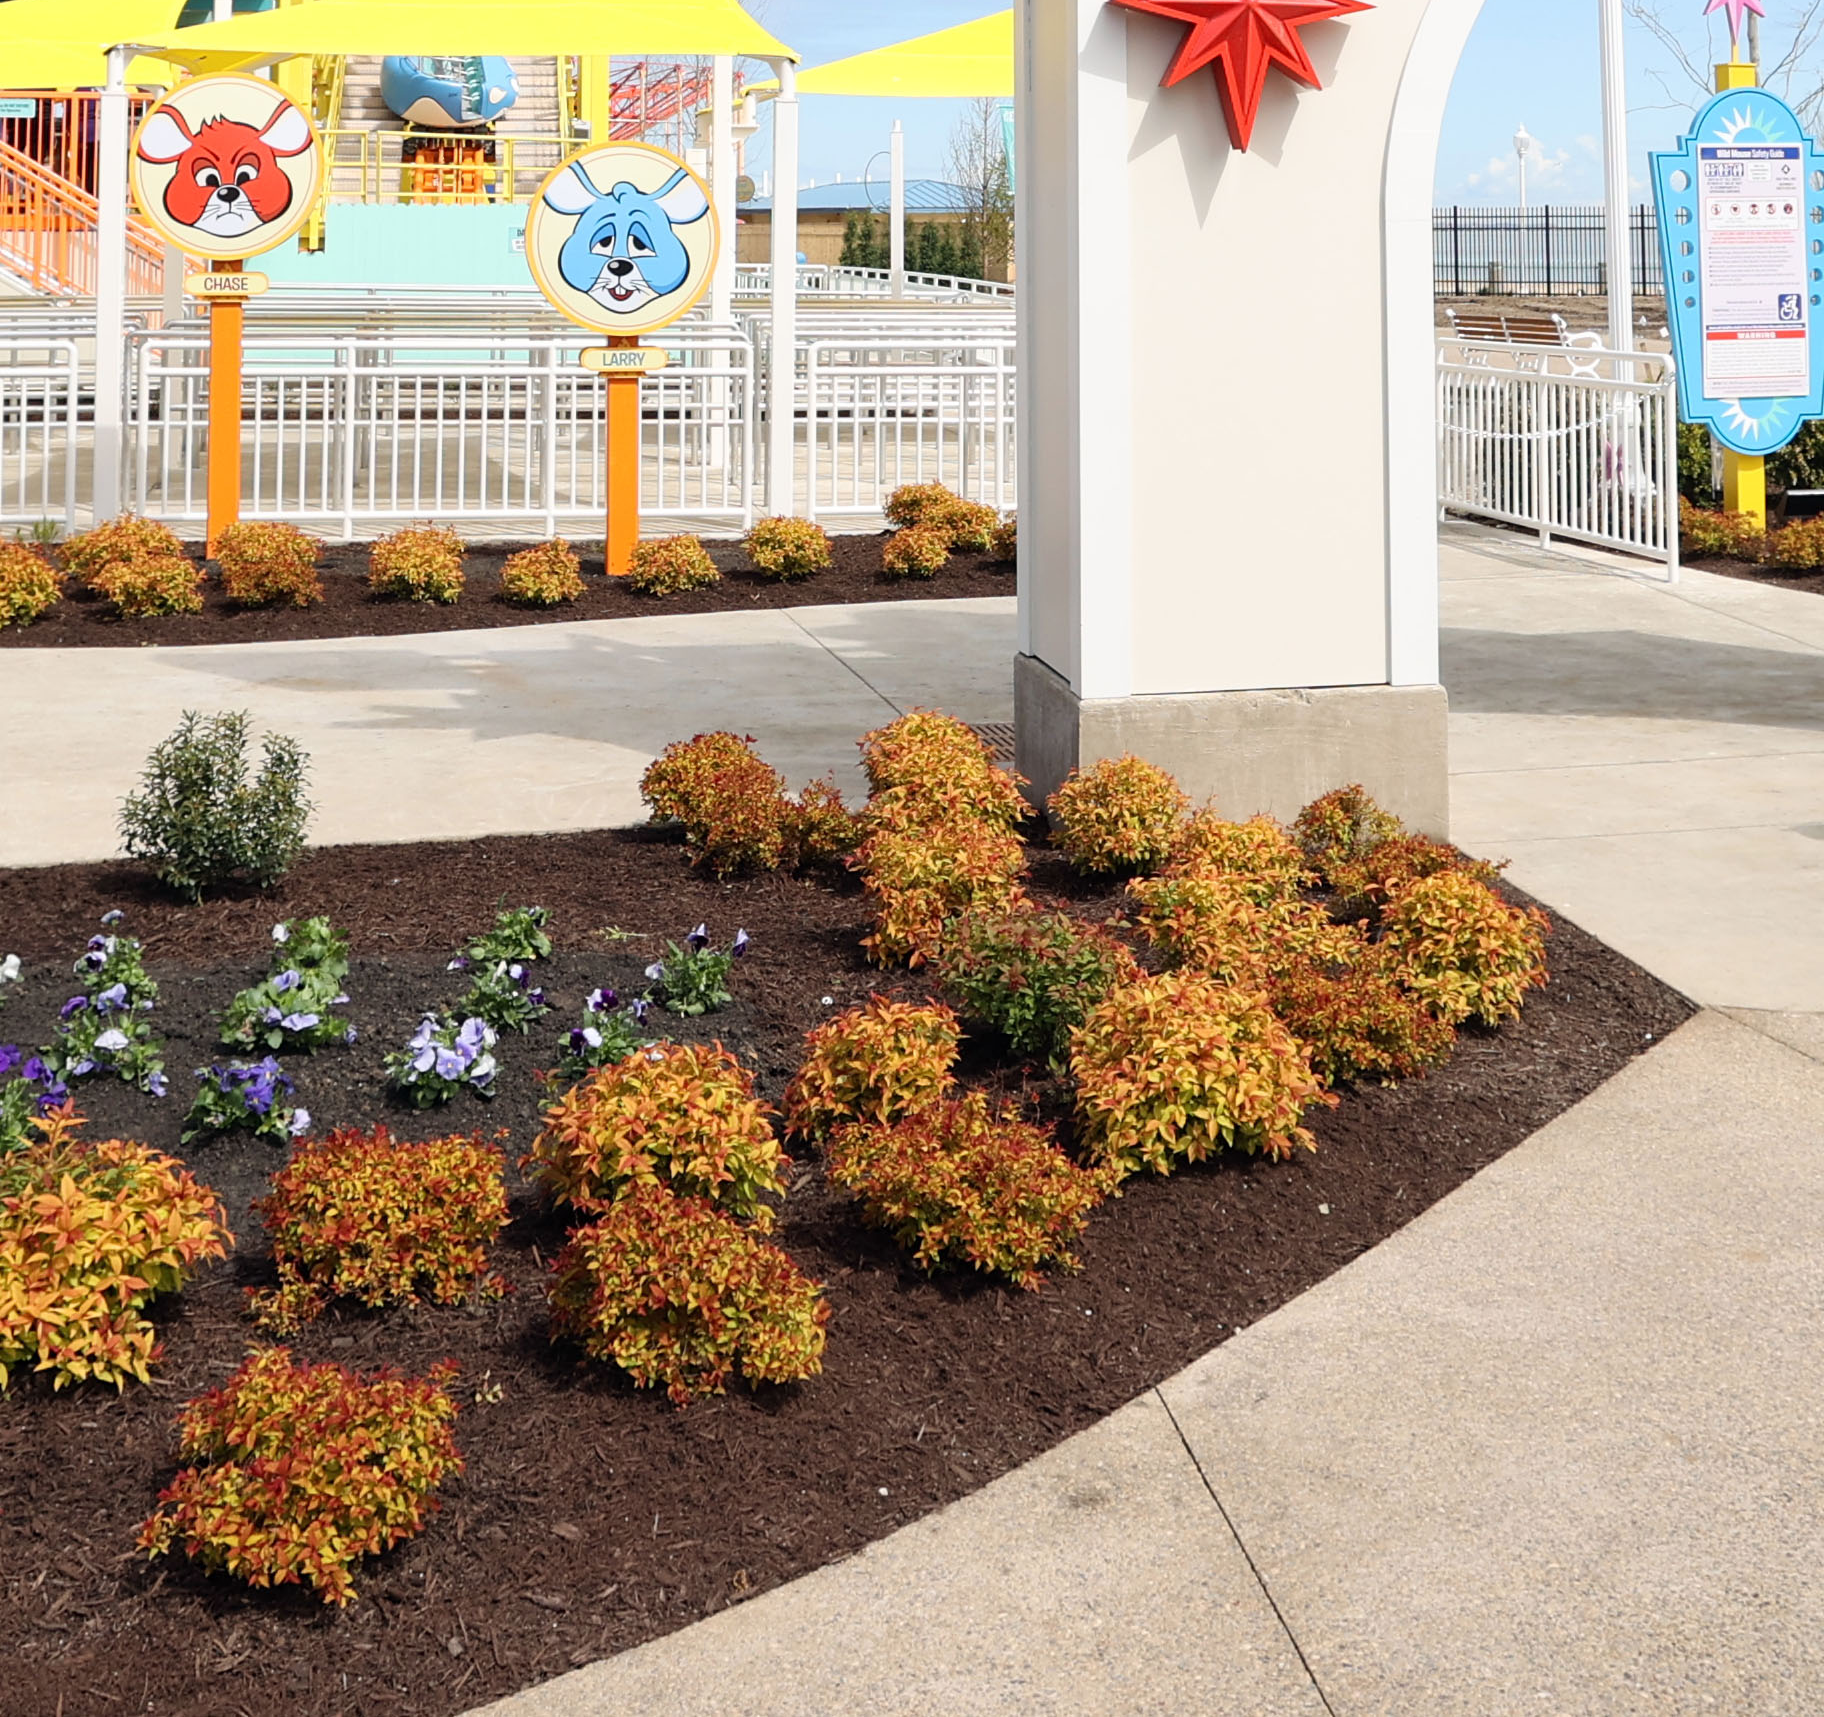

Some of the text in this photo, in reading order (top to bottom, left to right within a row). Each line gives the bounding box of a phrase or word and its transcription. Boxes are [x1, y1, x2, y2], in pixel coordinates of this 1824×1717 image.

[204, 277, 248, 291] CHASE
[1737, 331, 1776, 339] WARNING
[602, 352, 646, 366] LARRY
